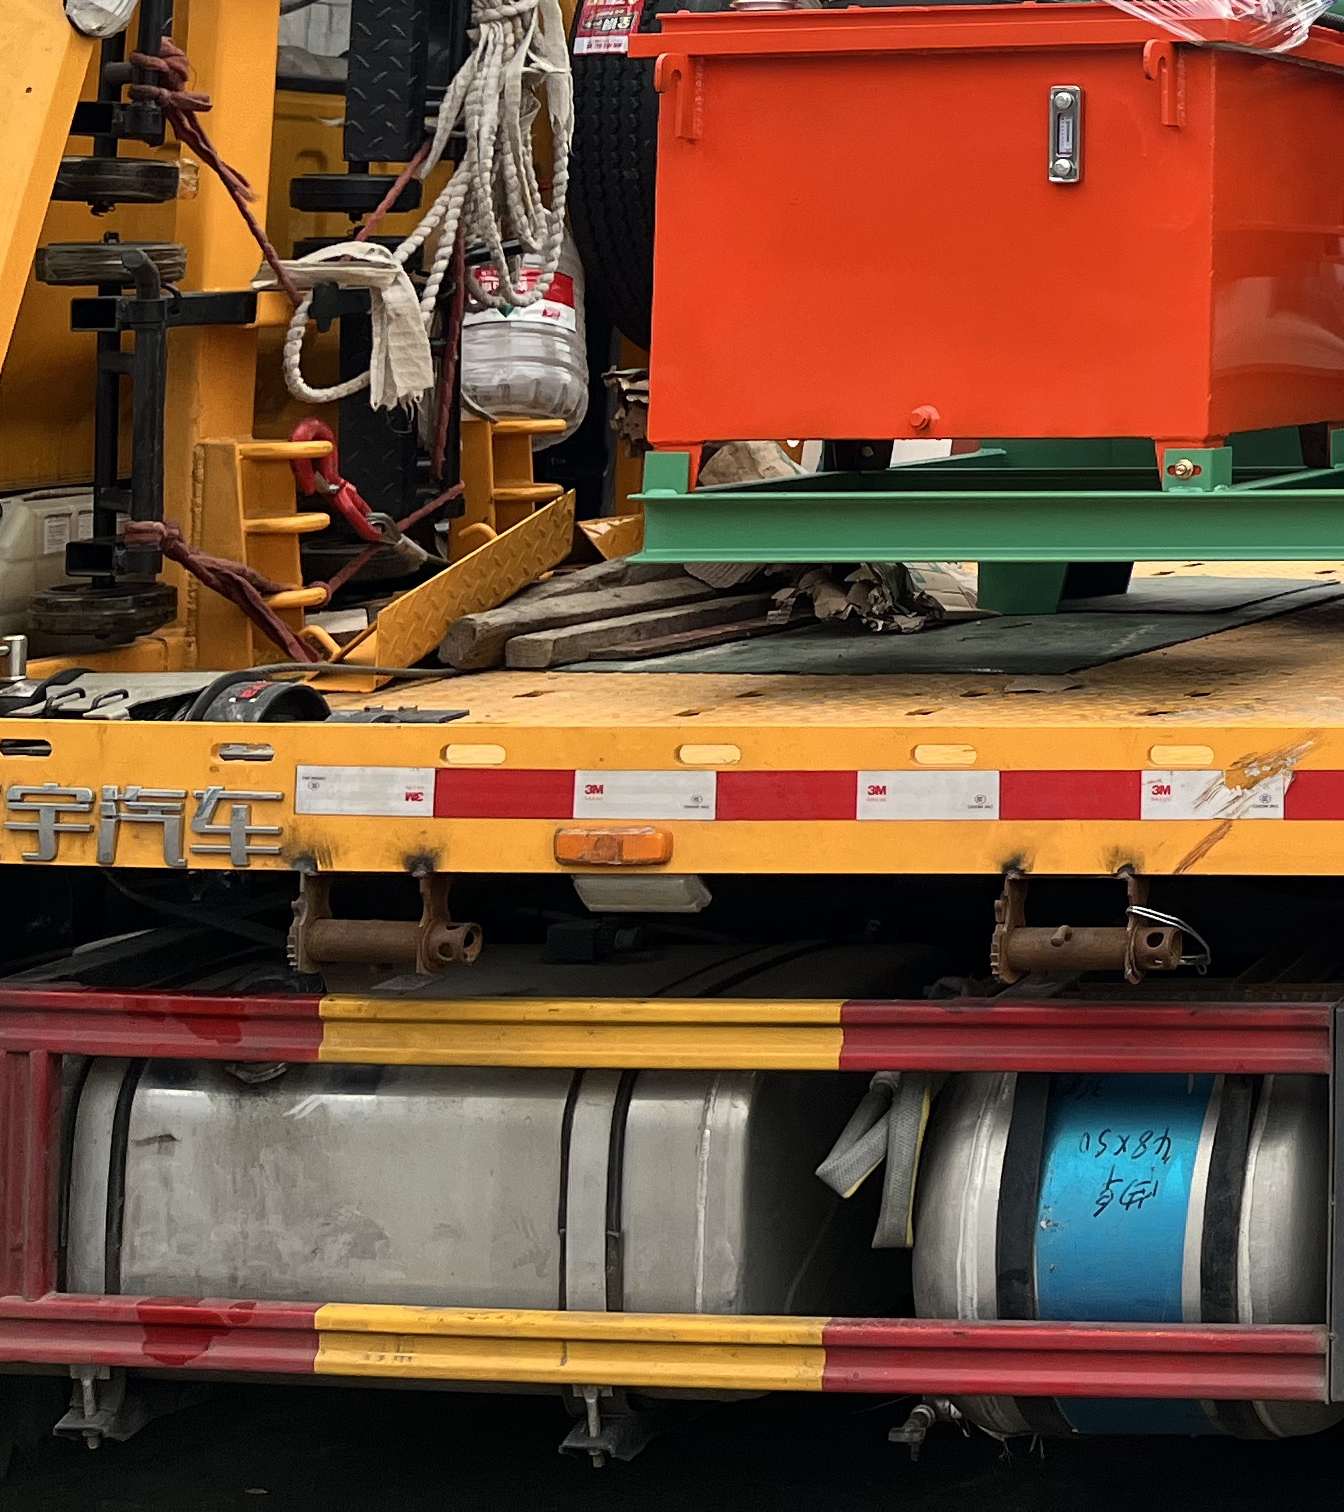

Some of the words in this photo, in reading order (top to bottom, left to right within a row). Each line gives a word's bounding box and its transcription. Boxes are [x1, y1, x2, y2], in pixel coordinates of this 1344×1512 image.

[584, 784, 604, 795] 3M
[866, 785, 887, 796] 3M
[1150, 785, 1171, 796] 3M
[405, 792, 424, 802] 3M
[4, 782, 286, 868] 宇汽车
